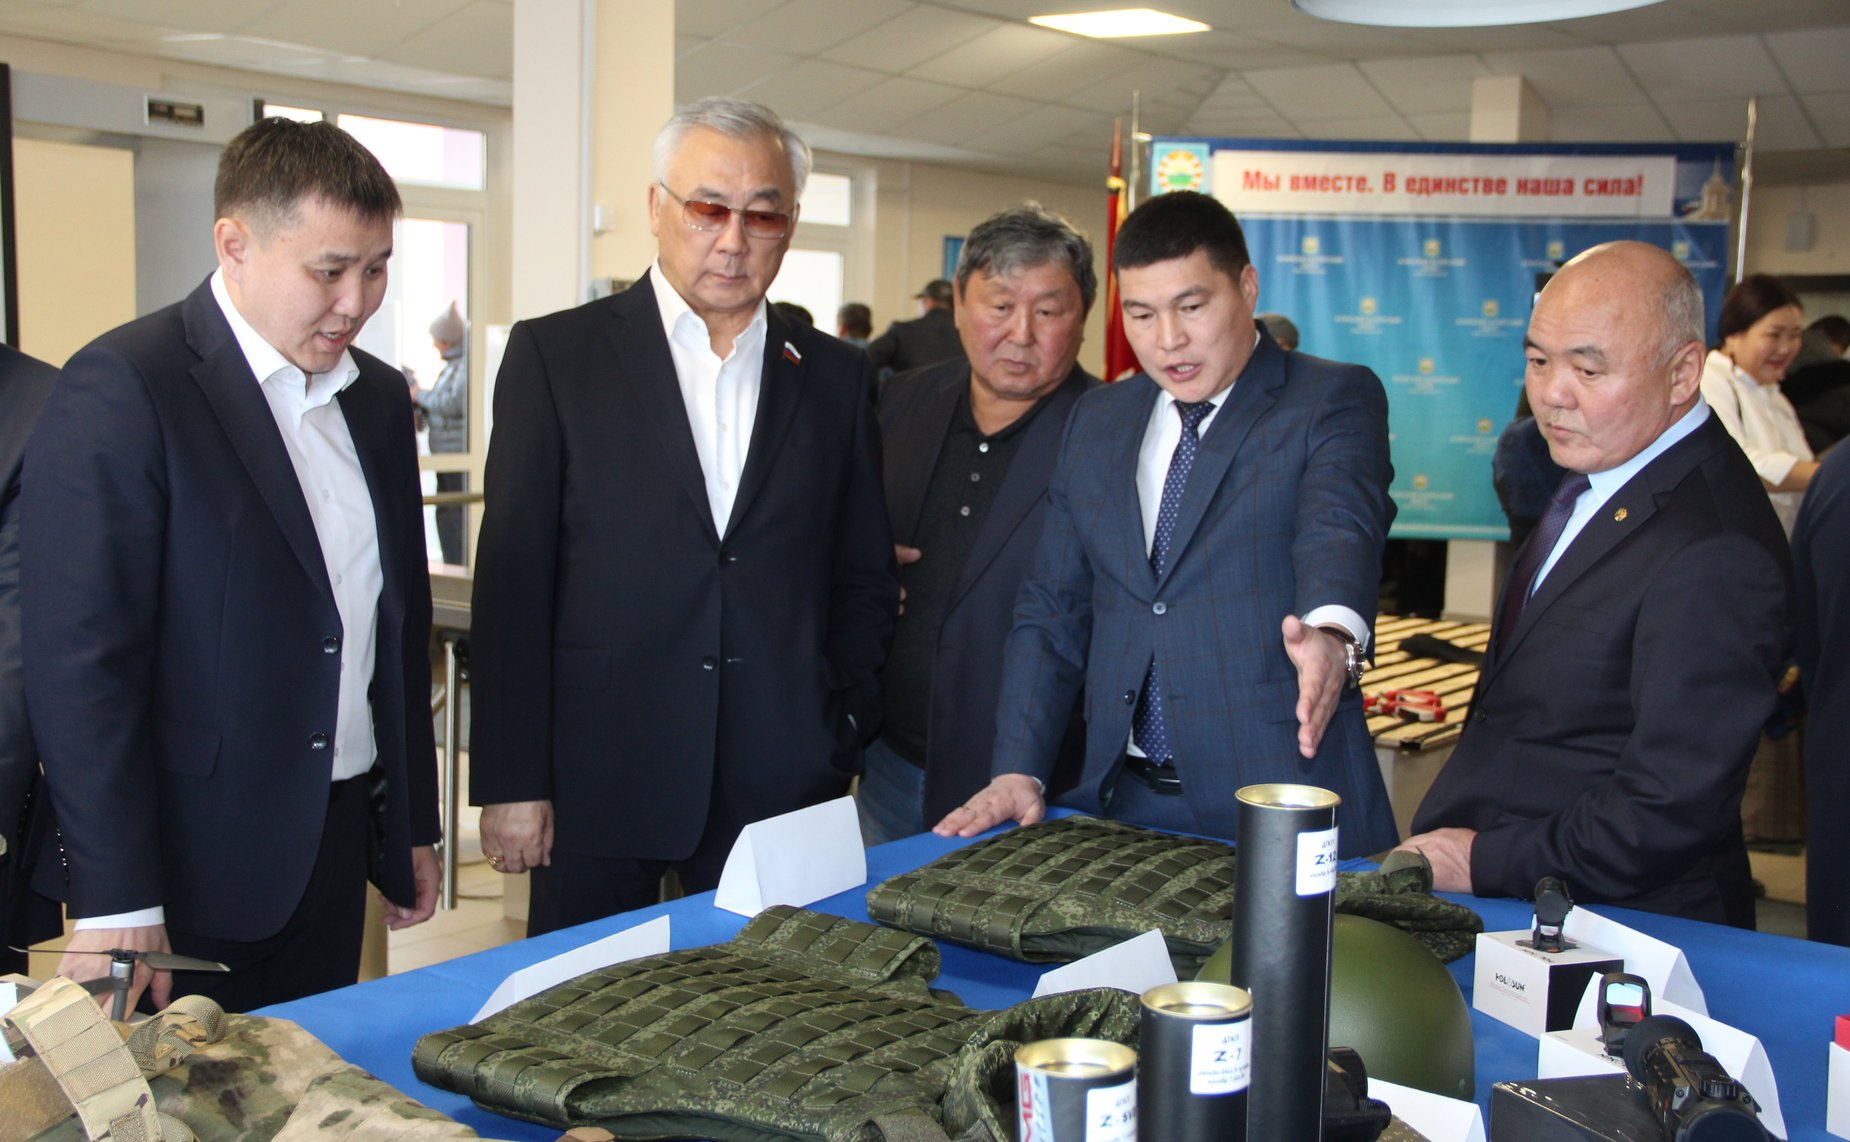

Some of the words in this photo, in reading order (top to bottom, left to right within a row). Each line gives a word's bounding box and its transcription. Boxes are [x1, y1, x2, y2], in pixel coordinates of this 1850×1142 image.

[1243, 170, 1280, 192] Мы
[1289, 174, 1373, 193] вместе.
[1383, 172, 1396, 193] В
[1405, 175, 1507, 197] единстве
[1516, 176, 1575, 196] наша
[1583, 174, 1644, 196] сила!
[1495, 972, 1525, 992] HOLOSUN
